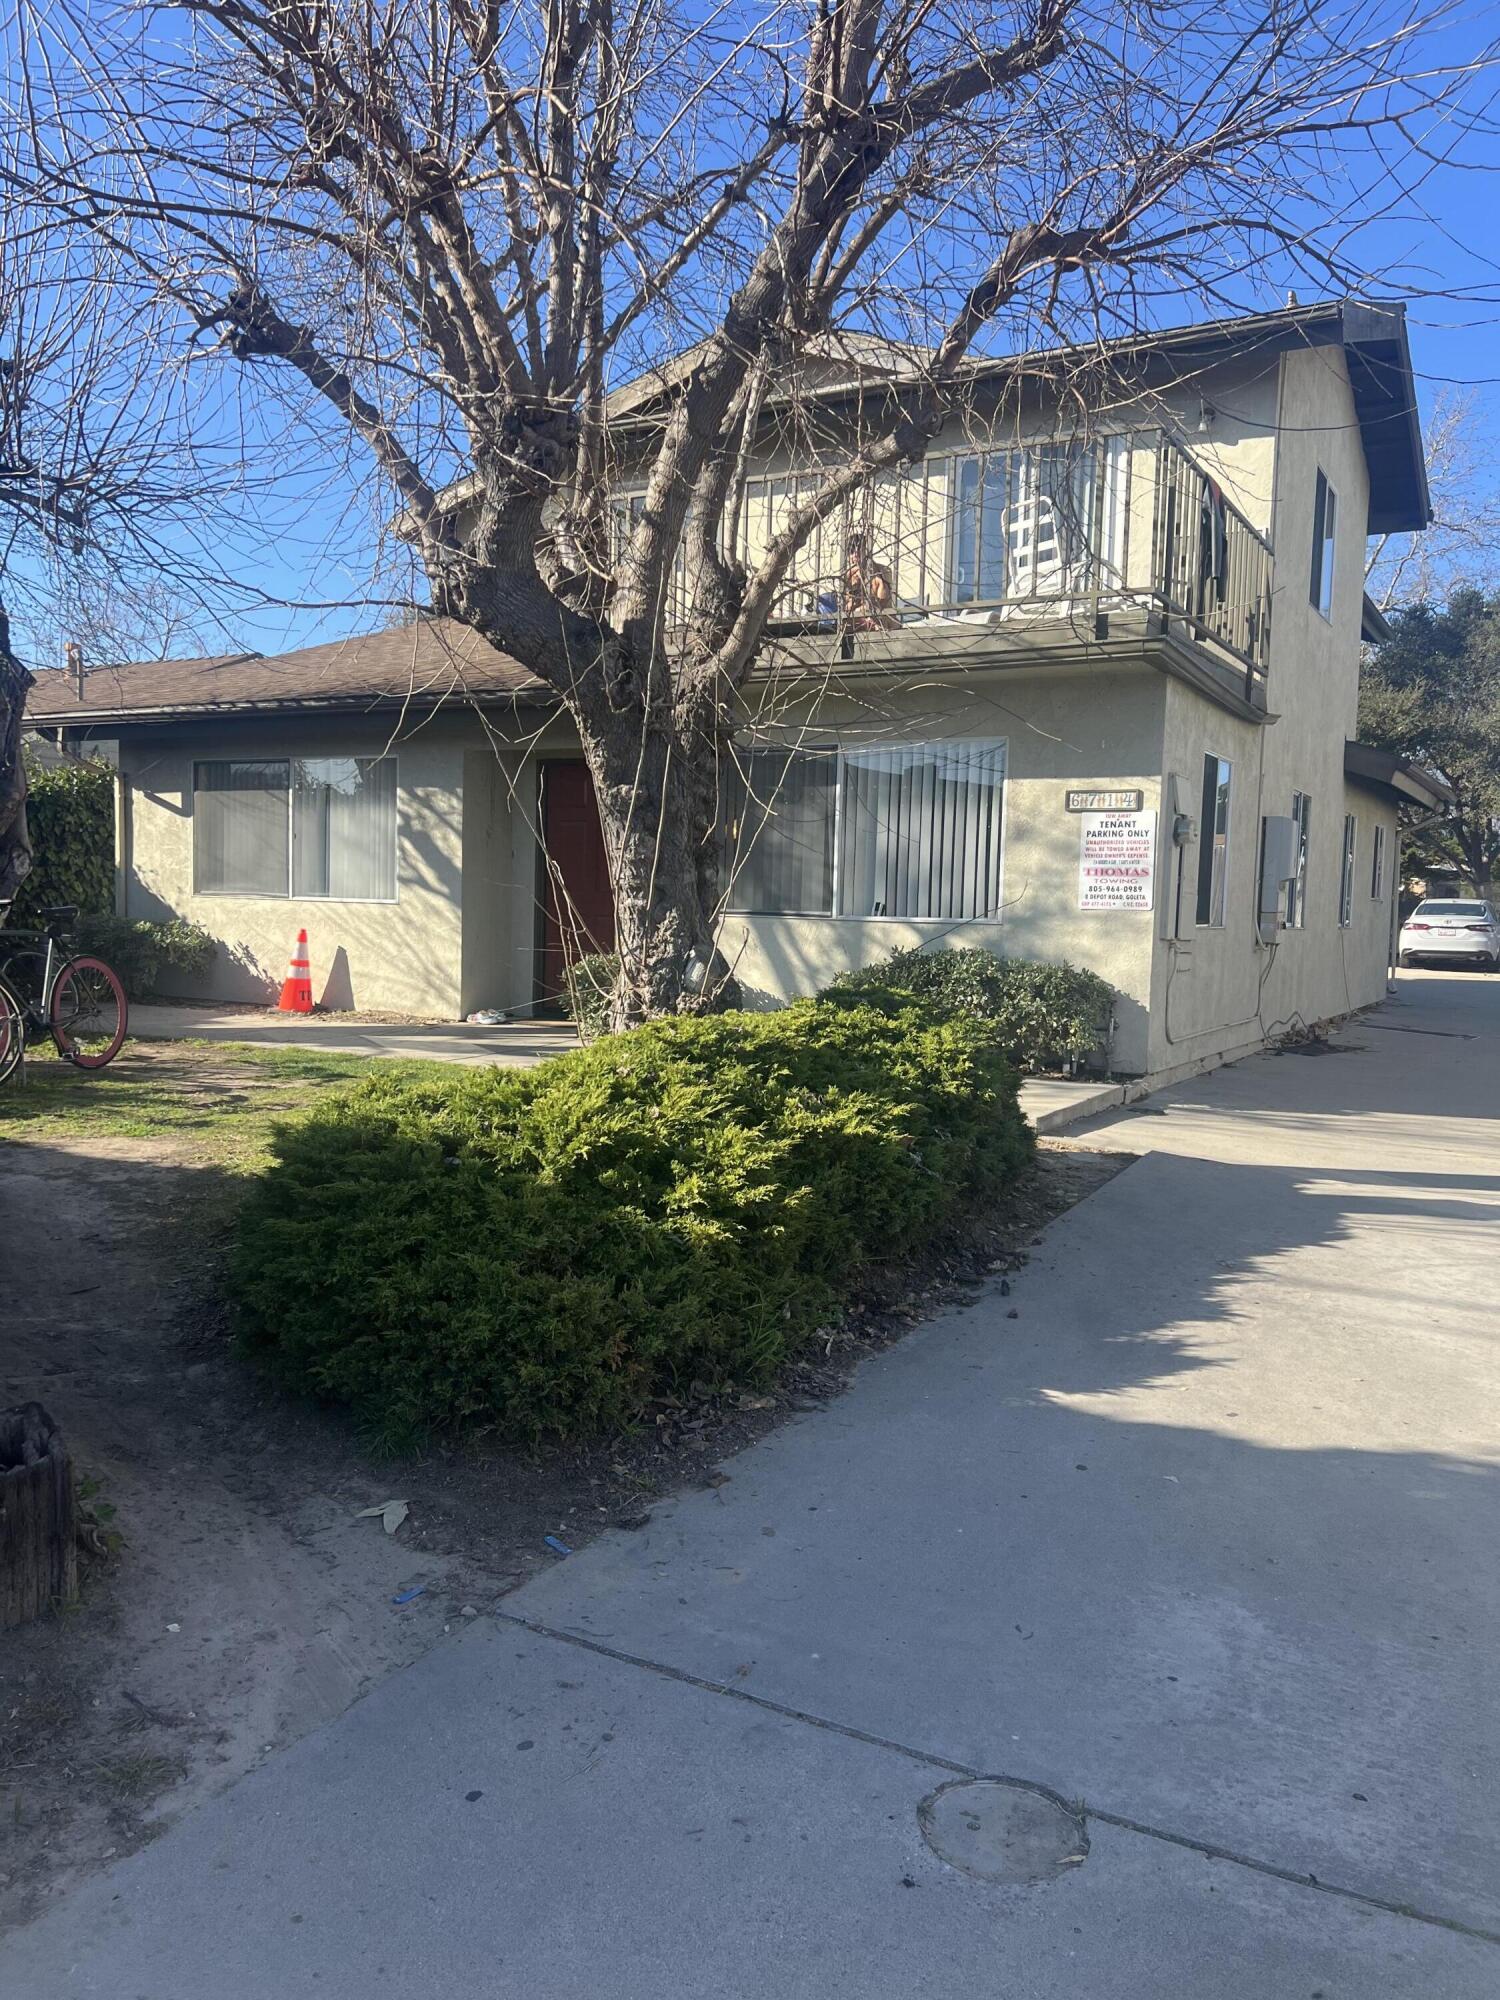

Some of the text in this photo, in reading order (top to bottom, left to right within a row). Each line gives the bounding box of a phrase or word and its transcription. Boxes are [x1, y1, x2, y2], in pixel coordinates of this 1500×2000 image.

[1071, 792, 1134, 808] 6714
[1100, 820, 1136, 829] TENANT
[1086, 830, 1150, 838] PARKING ONLY
[1084, 867, 1150, 877] THOMAS
